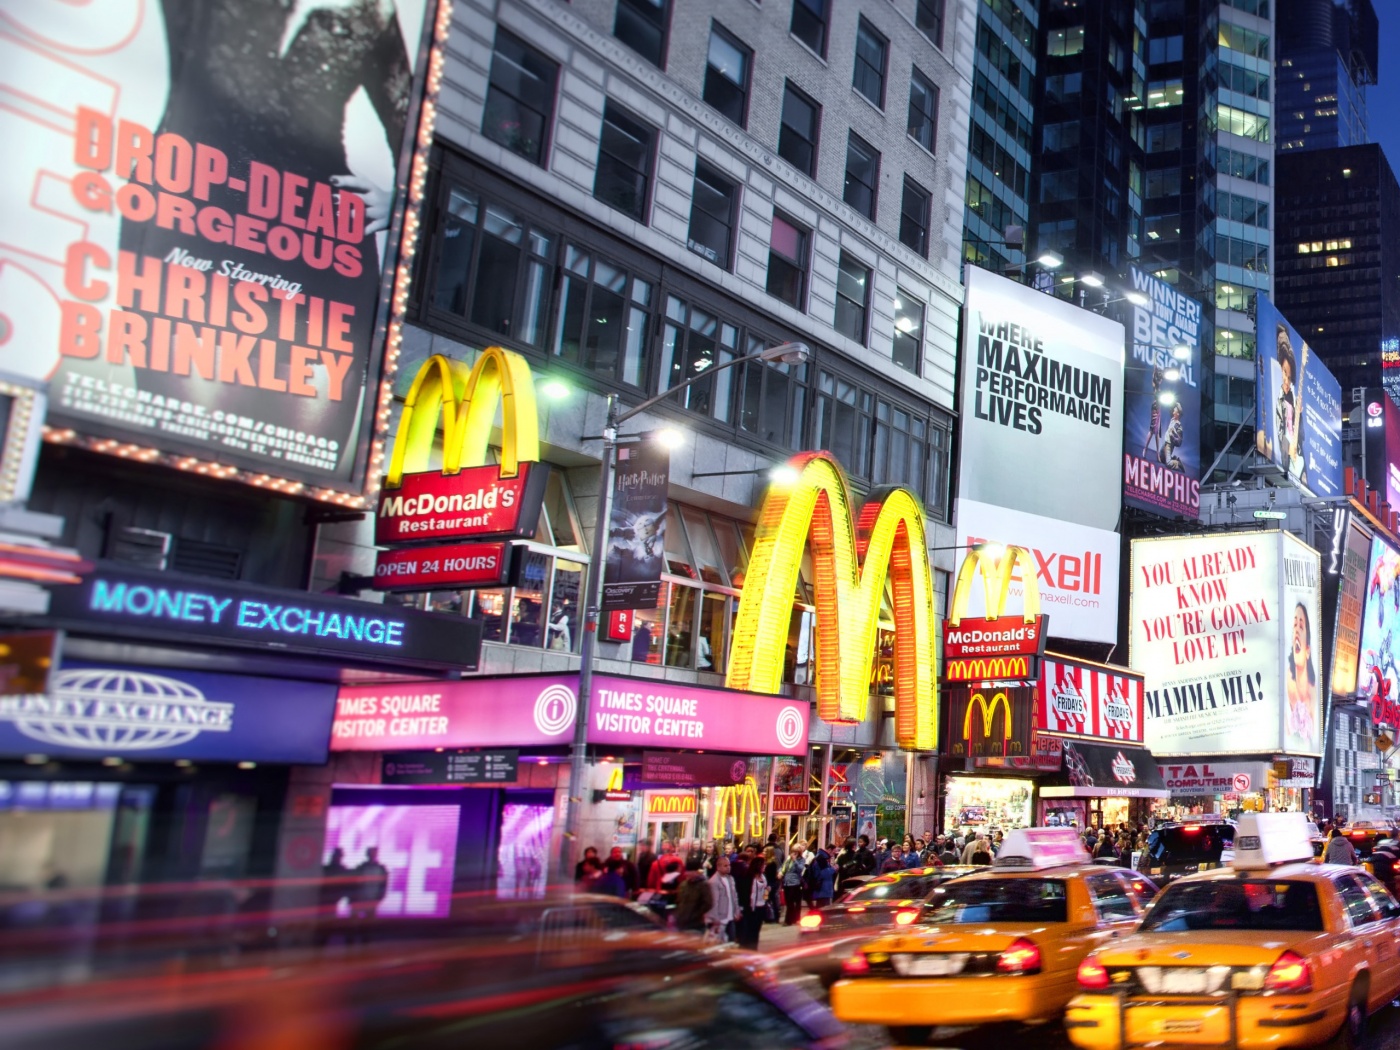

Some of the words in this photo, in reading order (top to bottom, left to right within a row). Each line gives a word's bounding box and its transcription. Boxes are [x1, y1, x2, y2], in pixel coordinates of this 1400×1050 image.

[74, 104, 366, 245] DROP-DEAD
[71, 171, 364, 278] GORGEOUS
[164, 246, 214, 273] Now
[216, 258, 303, 300] Starring
[63, 241, 356, 353] CHRISTIE
[1132, 267, 1200, 323] WINNER!
[1155, 302, 1173, 323] TONY
[59, 299, 354, 402] BRINKLEY
[979, 312, 1044, 353] WHERE
[1134, 307, 1197, 366] BEST
[977, 335, 1112, 407] MAXIMUM
[974, 390, 1042, 435] LIVES
[975, 370, 1111, 428] PERFORMANCE
[618, 474, 641, 492] Harry
[639, 470, 666, 489] Potter
[1125, 453, 1200, 508] MEMPHIS
[380, 486, 514, 518] McDonald's
[399, 514, 489, 533] Restaurant
[377, 561, 417, 577] OPEN
[421, 561, 439, 574] 24
[444, 556, 496, 571] HOURS
[1142, 560, 1175, 588] YOU
[1182, 545, 1256, 581] ALREADY
[90, 580, 233, 624] MONEY
[236, 600, 406, 646] EXCHANGE
[1177, 578, 1228, 609] KNOW
[947, 628, 1035, 644] McDonald's
[1142, 610, 1206, 642] YOU'RE
[1211, 598, 1270, 630] GONNA
[962, 643, 1020, 653] Restaurant
[1173, 635, 1218, 665] LOVE
[1223, 629, 1246, 656] IT!
[97, 699, 233, 724] EXCHANGE
[381, 694, 442, 715] SQUARE
[598, 690, 641, 712] TIMES
[645, 692, 698, 717] SQUARE
[1143, 681, 1218, 720] MAMMA
[1220, 671, 1264, 707] MIA!
[332, 717, 385, 737] VISITOR
[390, 716, 448, 736] CENTER
[596, 713, 648, 734] VISITOR
[651, 715, 704, 738] CENTER
